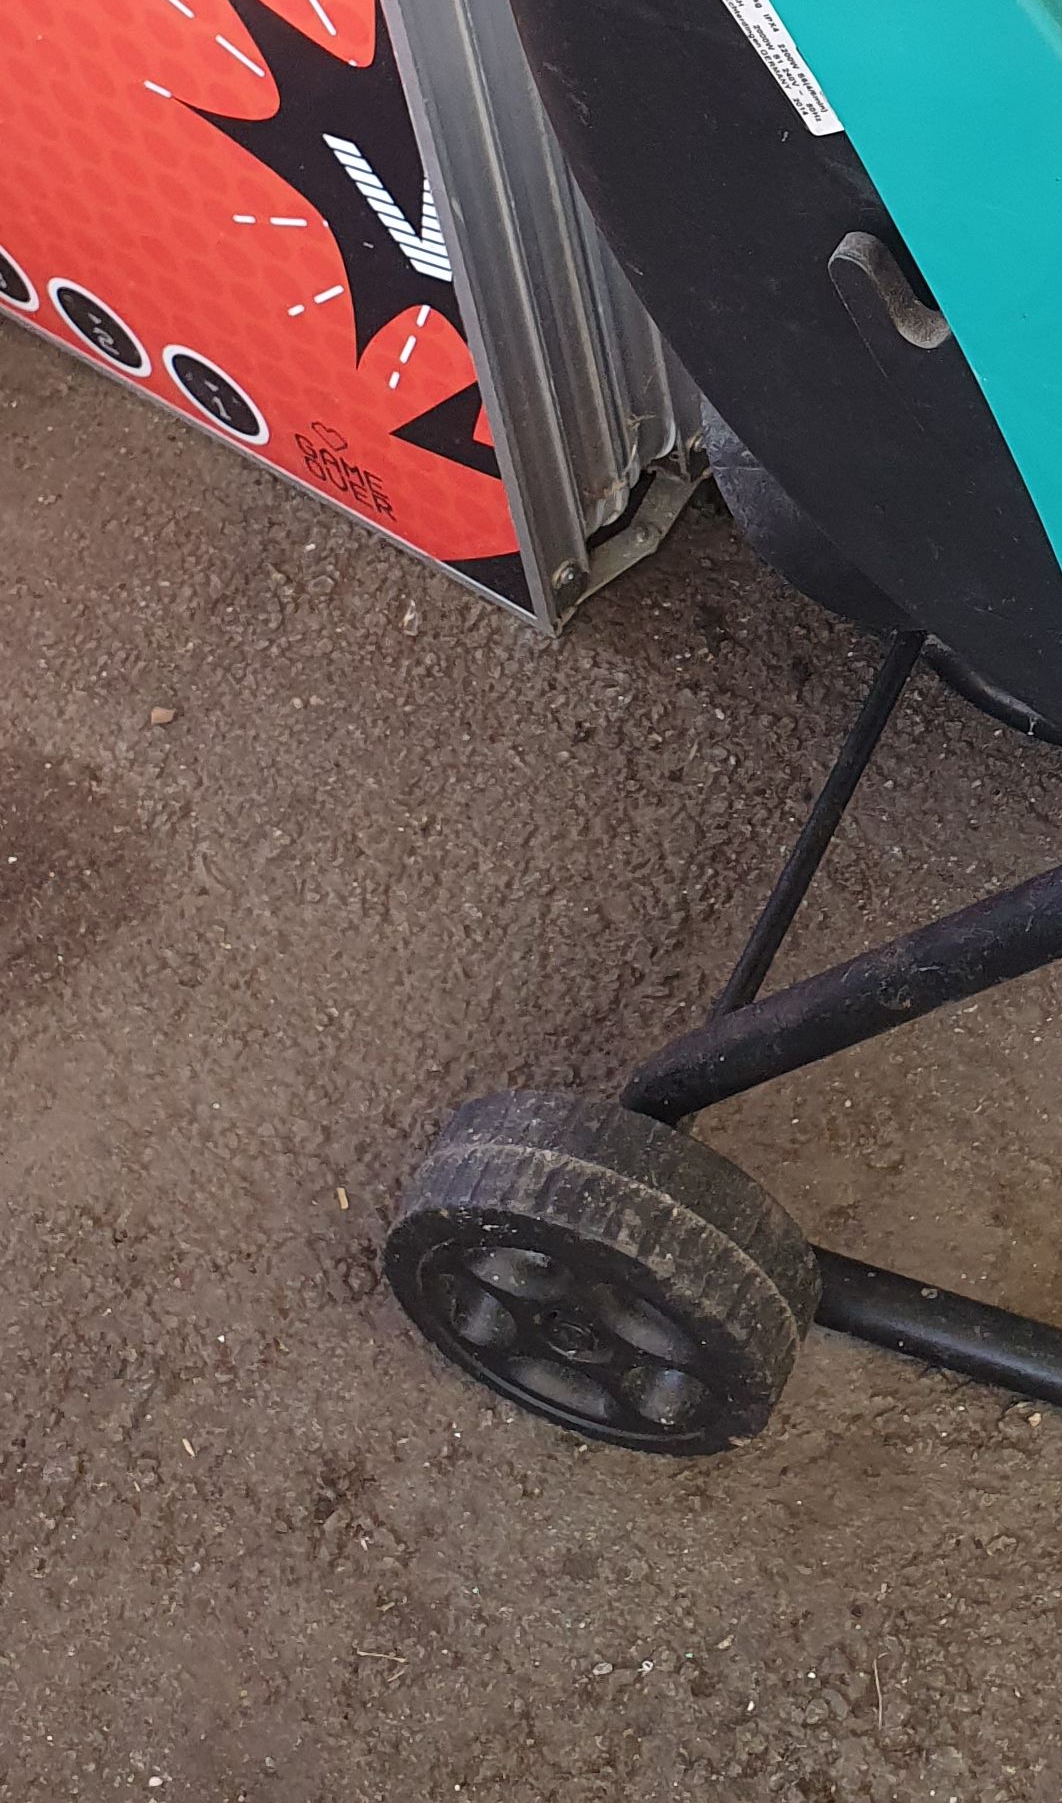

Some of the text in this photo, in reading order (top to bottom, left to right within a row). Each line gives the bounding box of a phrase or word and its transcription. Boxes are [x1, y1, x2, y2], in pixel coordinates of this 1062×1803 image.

[763, 13, 780, 33] IPX4
[778, 43, 800, 70] 2200W
[760, 49, 791, 90] GERMANY
[793, 98, 808, 116] 2014
[782, 67, 799, 87] 240V
[295, 433, 383, 490] GAME
